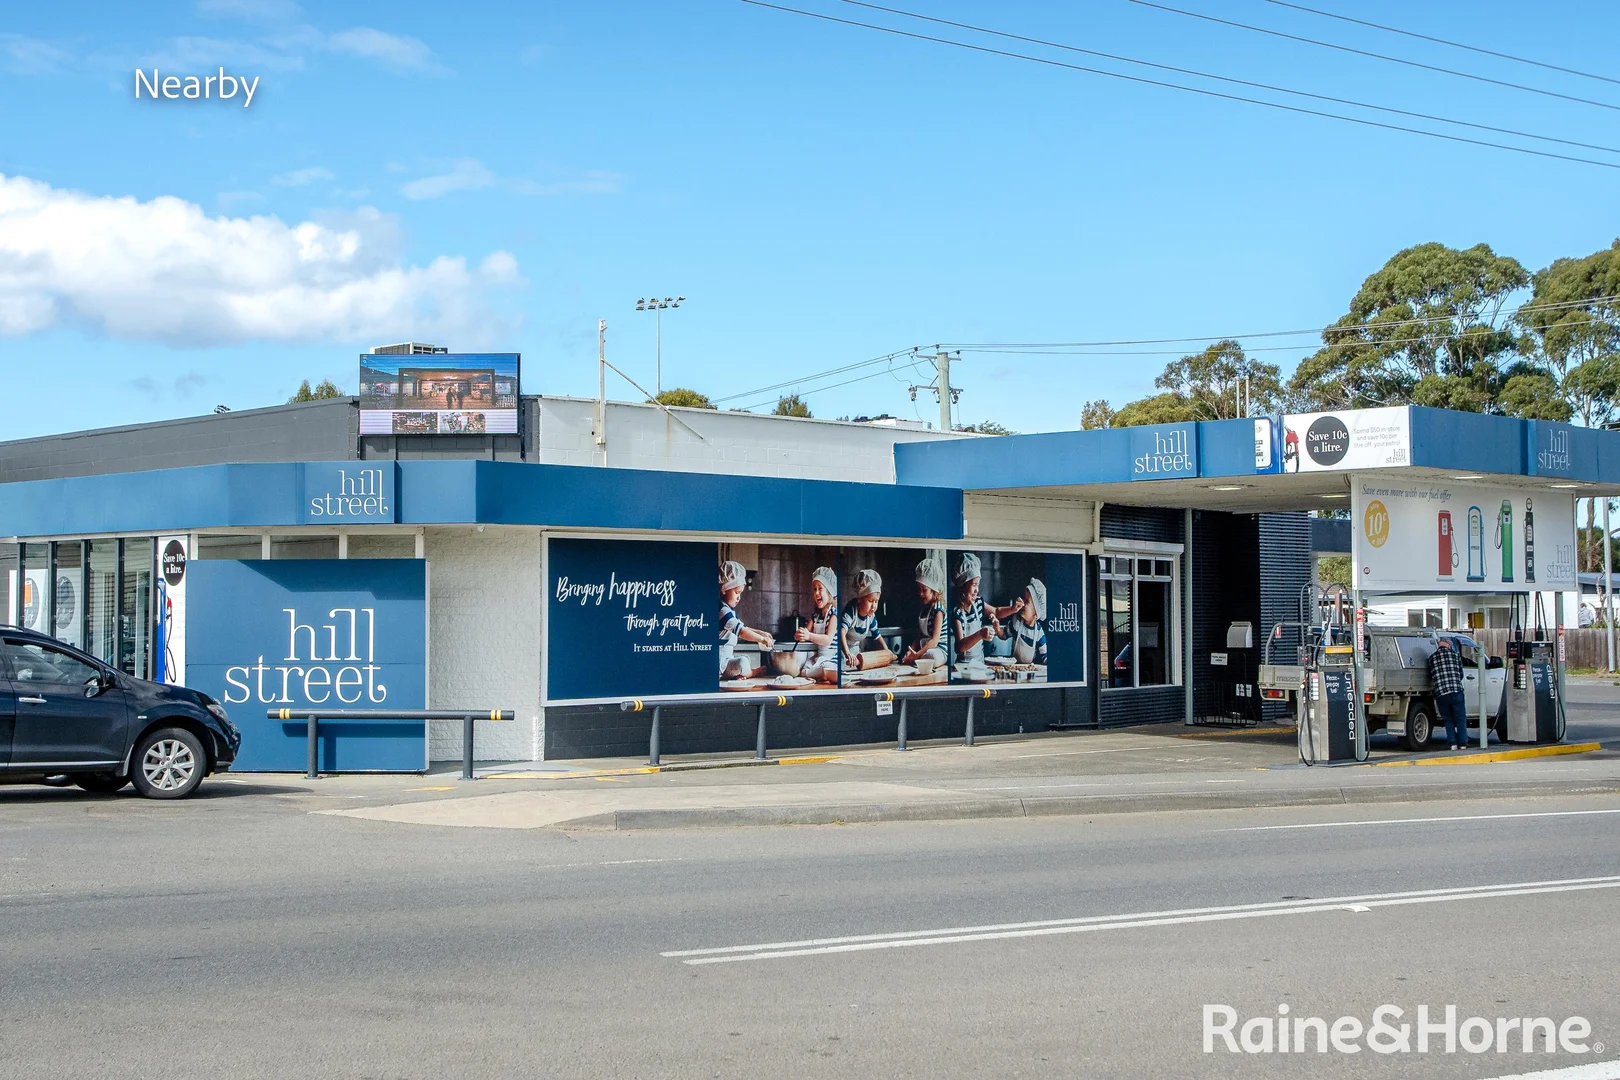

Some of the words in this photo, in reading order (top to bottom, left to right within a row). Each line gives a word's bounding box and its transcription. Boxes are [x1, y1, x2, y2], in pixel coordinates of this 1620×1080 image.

[1308, 431, 1330, 442] Save
[1332, 429, 1348, 440] 10c
[1353, 427, 1370, 435] Spend
[1370, 426, 1381, 434] $50
[1154, 430, 1188, 455] hill
[1313, 445, 1320, 453] a
[1321, 441, 1343, 453] litre.
[1549, 429, 1568, 453] hill
[1134, 452, 1193, 474] street
[1385, 455, 1408, 464] street
[1393, 448, 1406, 458] hill
[1537, 448, 1571, 471] street
[338, 469, 383, 496] hill
[1361, 483, 1376, 496] Save
[1376, 487, 1389, 497] even
[1390, 488, 1405, 498] more
[1404, 486, 1418, 499] with
[1418, 490, 1429, 499] our
[1427, 487, 1440, 502] fuel
[1439, 489, 1452, 503] offer
[310, 492, 389, 516] street
[163, 552, 176, 563] Save
[176, 553, 186, 563] 10c
[1556, 544, 1573, 564] hill
[166, 566, 170, 574] a
[1546, 560, 1576, 579] street
[556, 576, 606, 606] Bringing
[608, 571, 678, 609] happiness
[1059, 602, 1078, 620] hill
[623, 613, 660, 637] through
[661, 613, 685, 637] great
[1048, 616, 1080, 632] street
[282, 608, 375, 661] hill
[224, 654, 387, 704] street
